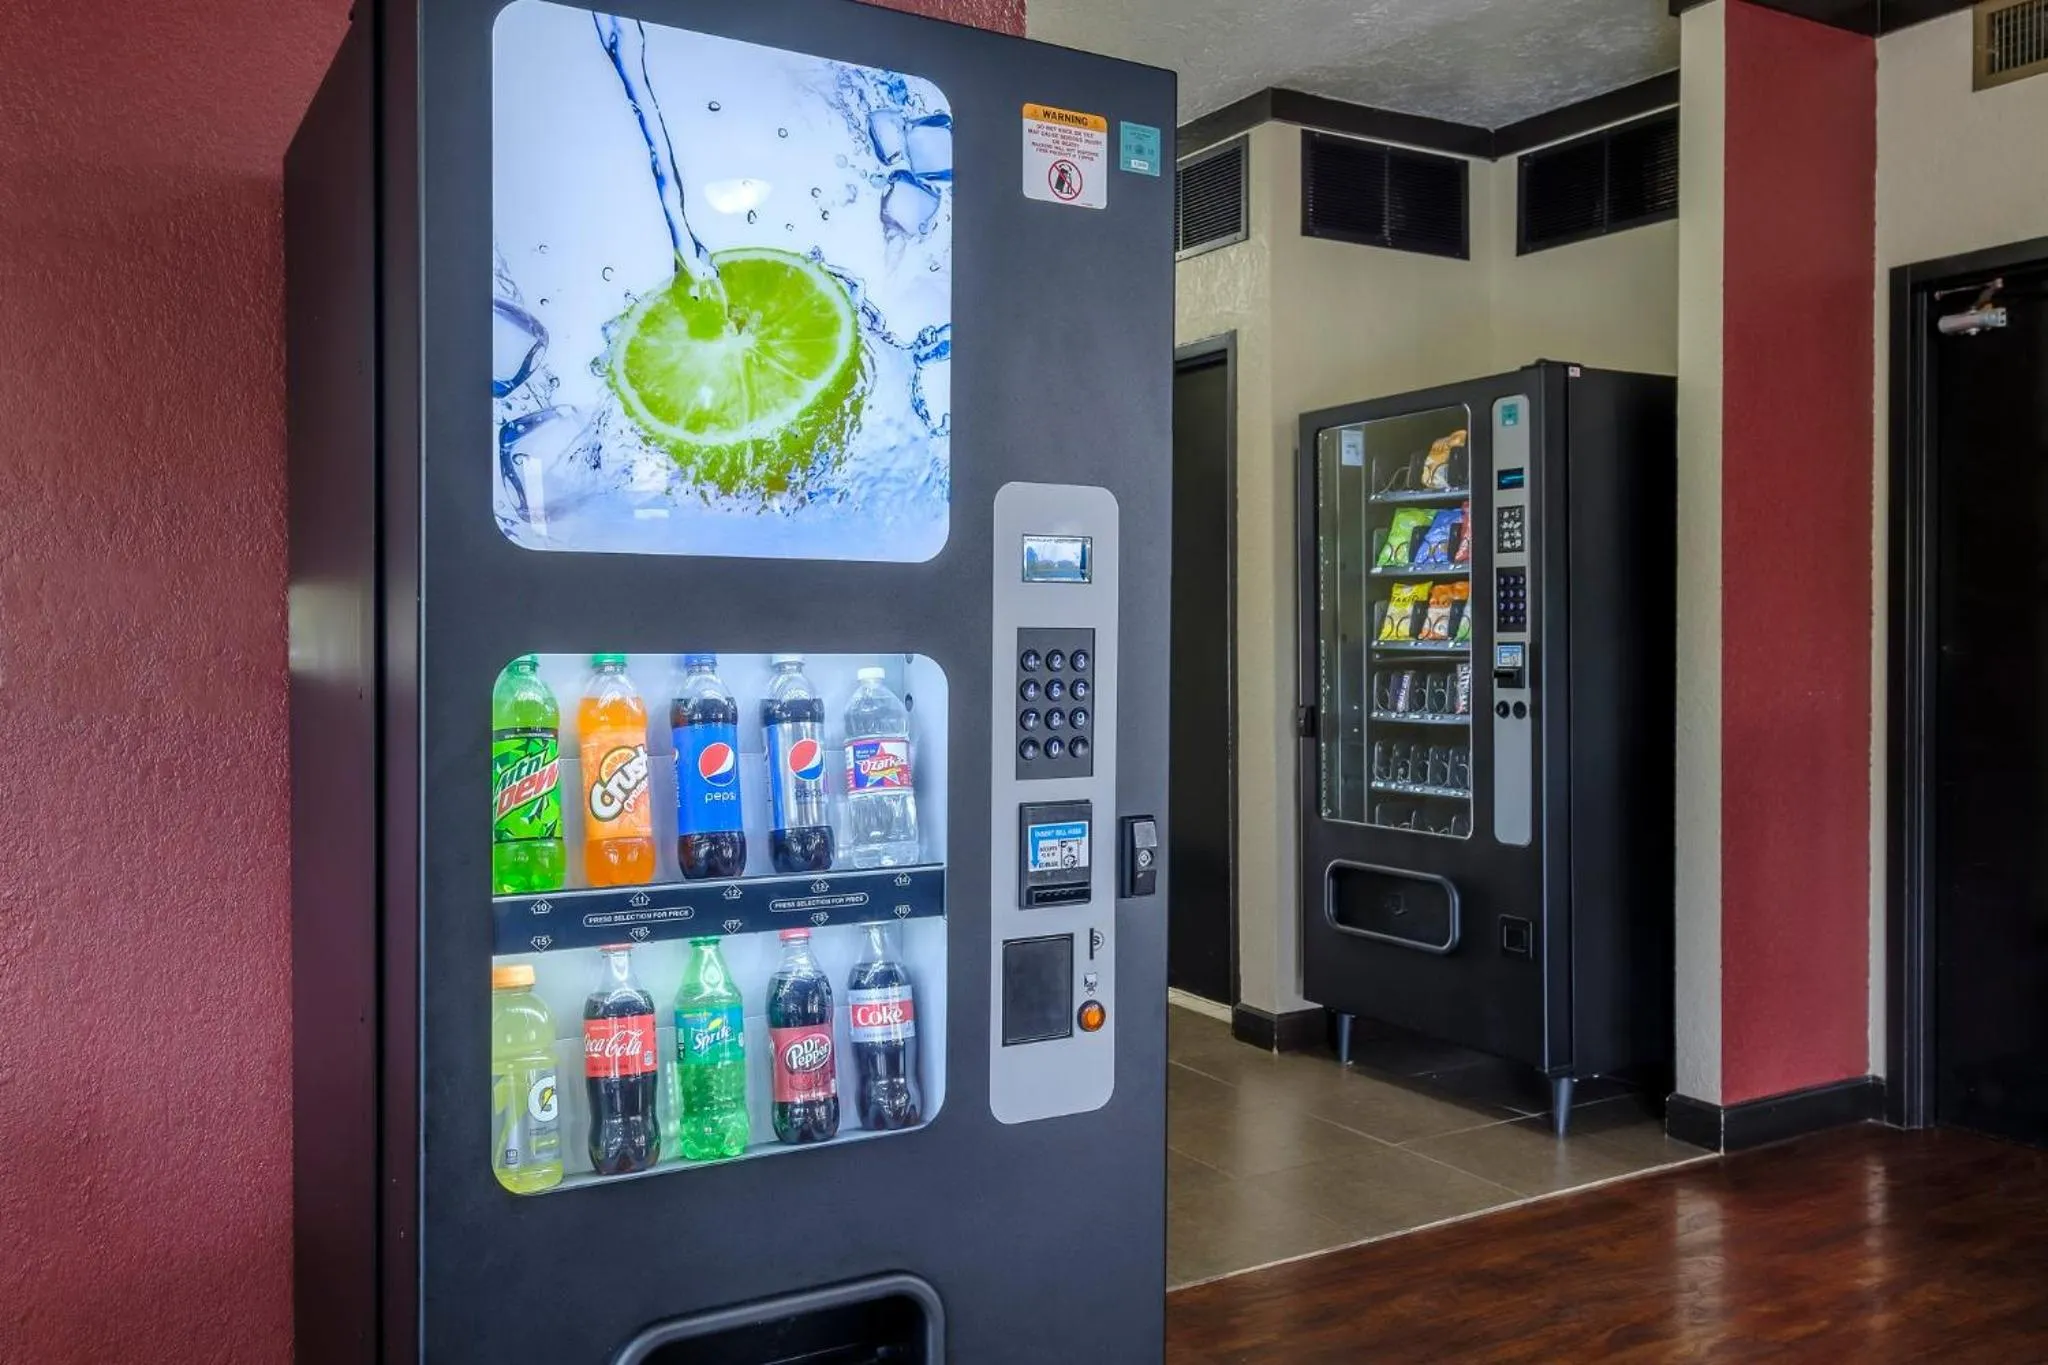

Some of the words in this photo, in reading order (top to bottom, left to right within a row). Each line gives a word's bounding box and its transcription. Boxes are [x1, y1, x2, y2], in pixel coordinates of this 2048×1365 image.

[1042, 109, 1089, 126] WARNING
[1054, 654, 1061, 668] 2
[1077, 654, 1085, 668] 3
[1027, 683, 1035, 697] 4
[1076, 683, 1085, 697] 6
[1029, 713, 1036, 727] 7
[1053, 712, 1060, 726] 8
[1076, 712, 1085, 725] 9
[1052, 741, 1059, 755] 0
[728, 889, 737, 897] 12
[537, 903, 546, 911] 10
[613, 912, 652, 922] SELECTION
[653, 910, 667, 919] FOR
[668, 908, 689, 917] PRICE
[537, 937, 546, 945] 15
[856, 1003, 904, 1026] Coke
[693, 1025, 732, 1052] Sprite
[803, 1038, 820, 1054] Dr
[787, 1043, 828, 1069] Pepper
[528, 1075, 558, 1122] G
